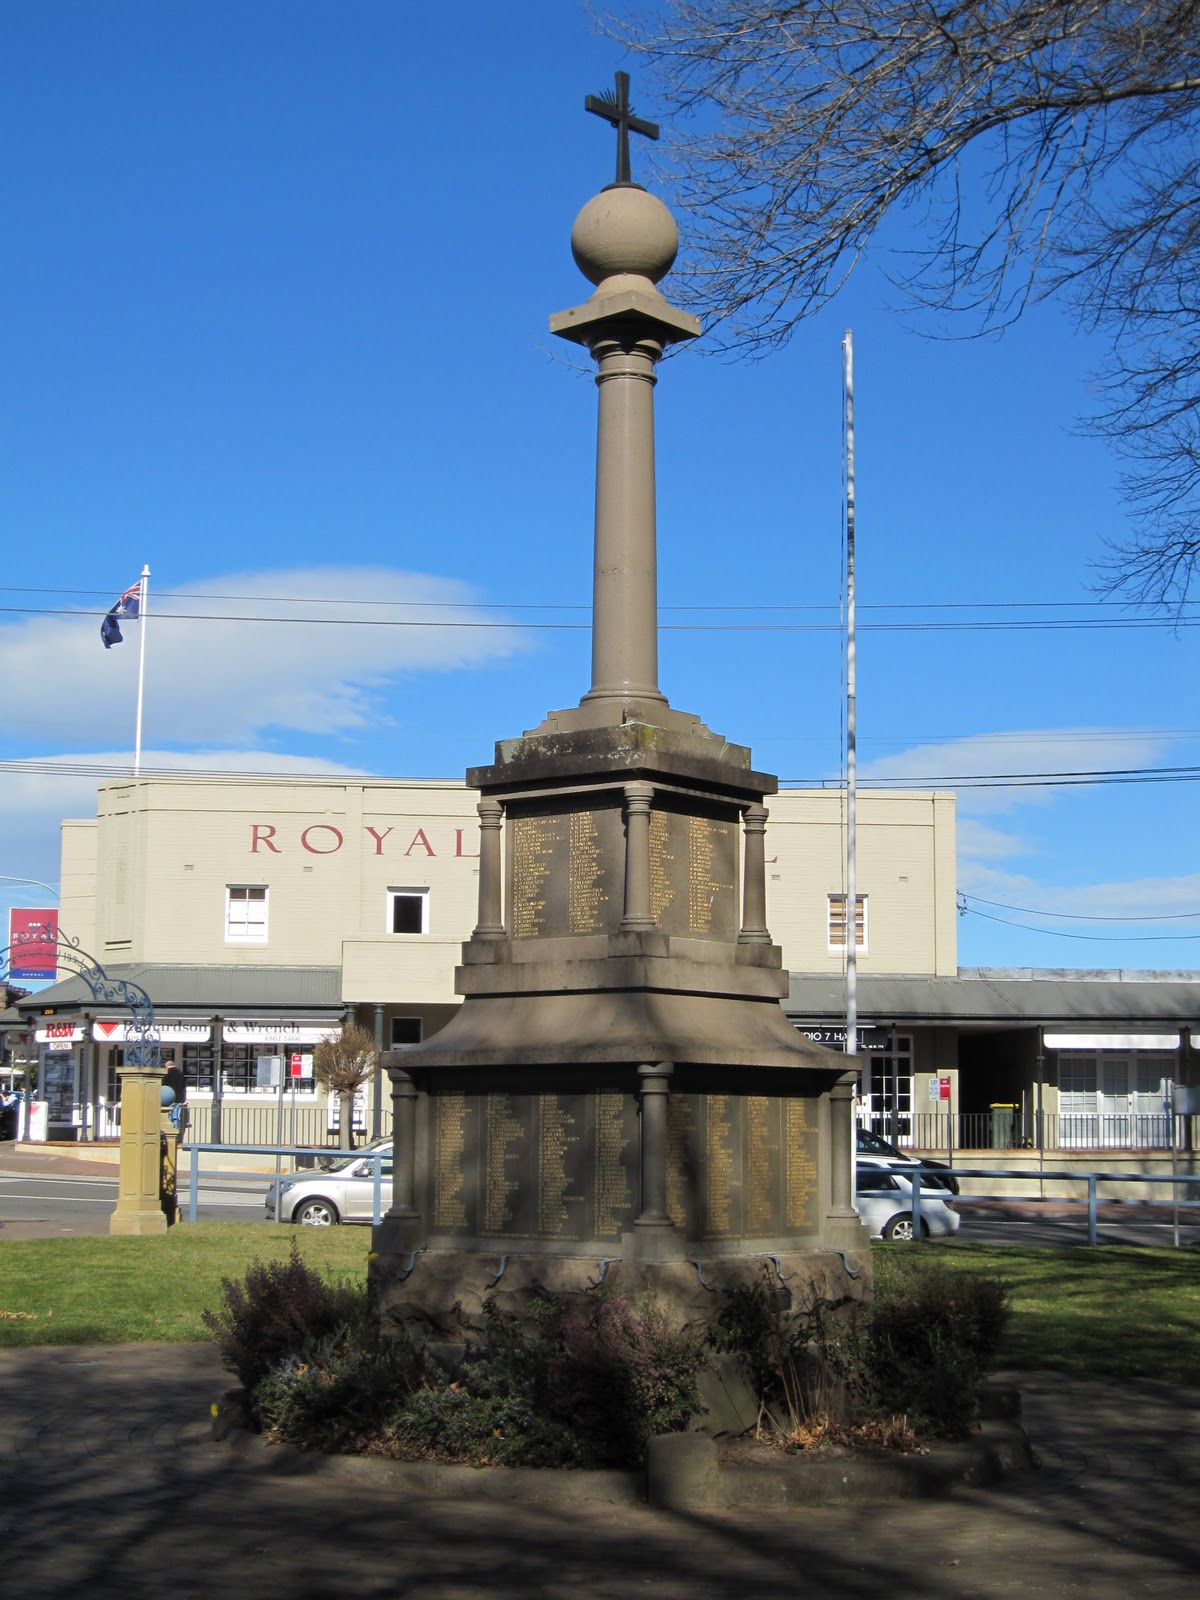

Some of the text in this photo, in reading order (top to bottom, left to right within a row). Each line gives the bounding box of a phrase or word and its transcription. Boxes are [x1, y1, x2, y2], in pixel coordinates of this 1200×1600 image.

[248, 824, 481, 858] ROYAL
[12, 932, 56, 940] ROYAL
[45, 1022, 77, 1038] R&W
[122, 1019, 300, 1034] Rardson & Wrench
[825, 1032, 831, 1041] 7
